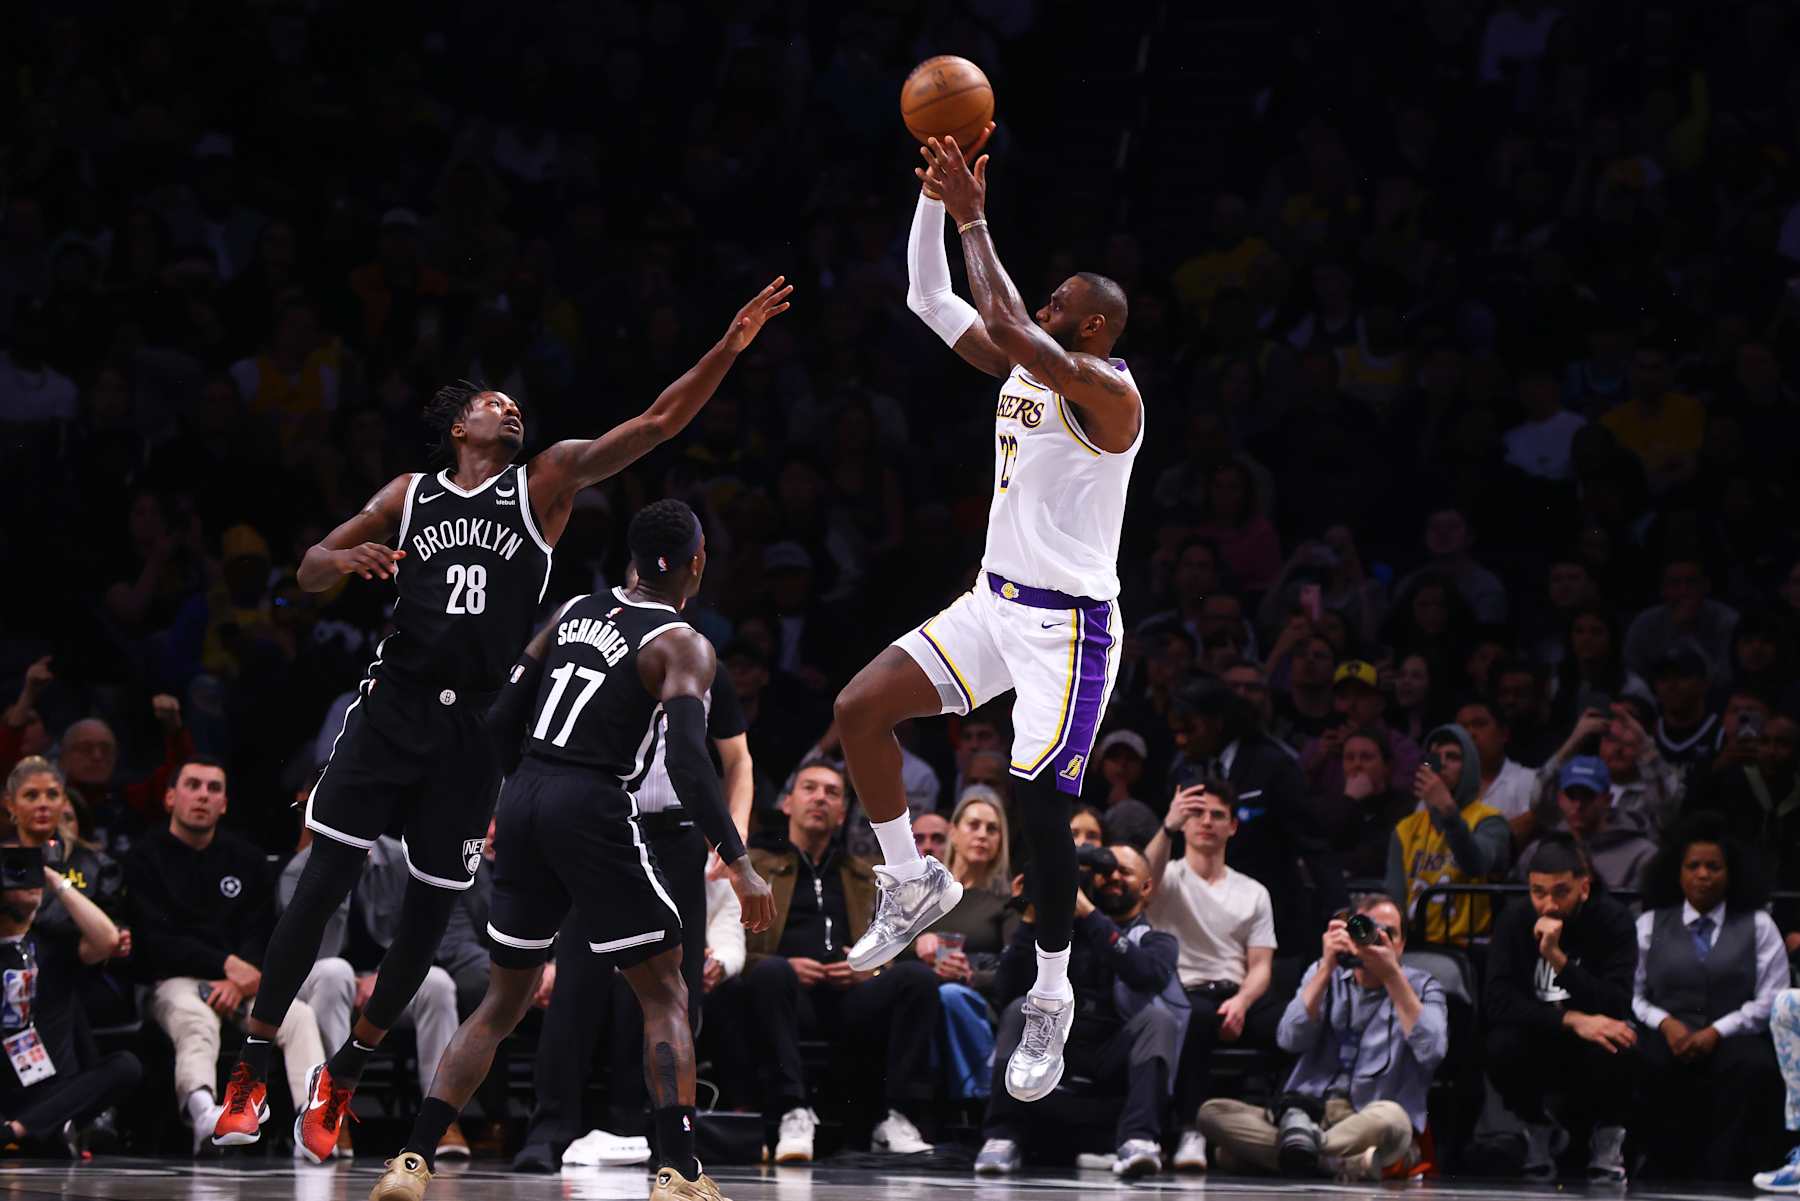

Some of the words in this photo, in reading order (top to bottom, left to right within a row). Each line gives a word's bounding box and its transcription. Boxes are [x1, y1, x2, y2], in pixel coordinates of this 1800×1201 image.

[412, 518, 524, 562] BROOKLYN
[446, 564, 487, 615] 28
[532, 662, 606, 748] 17
